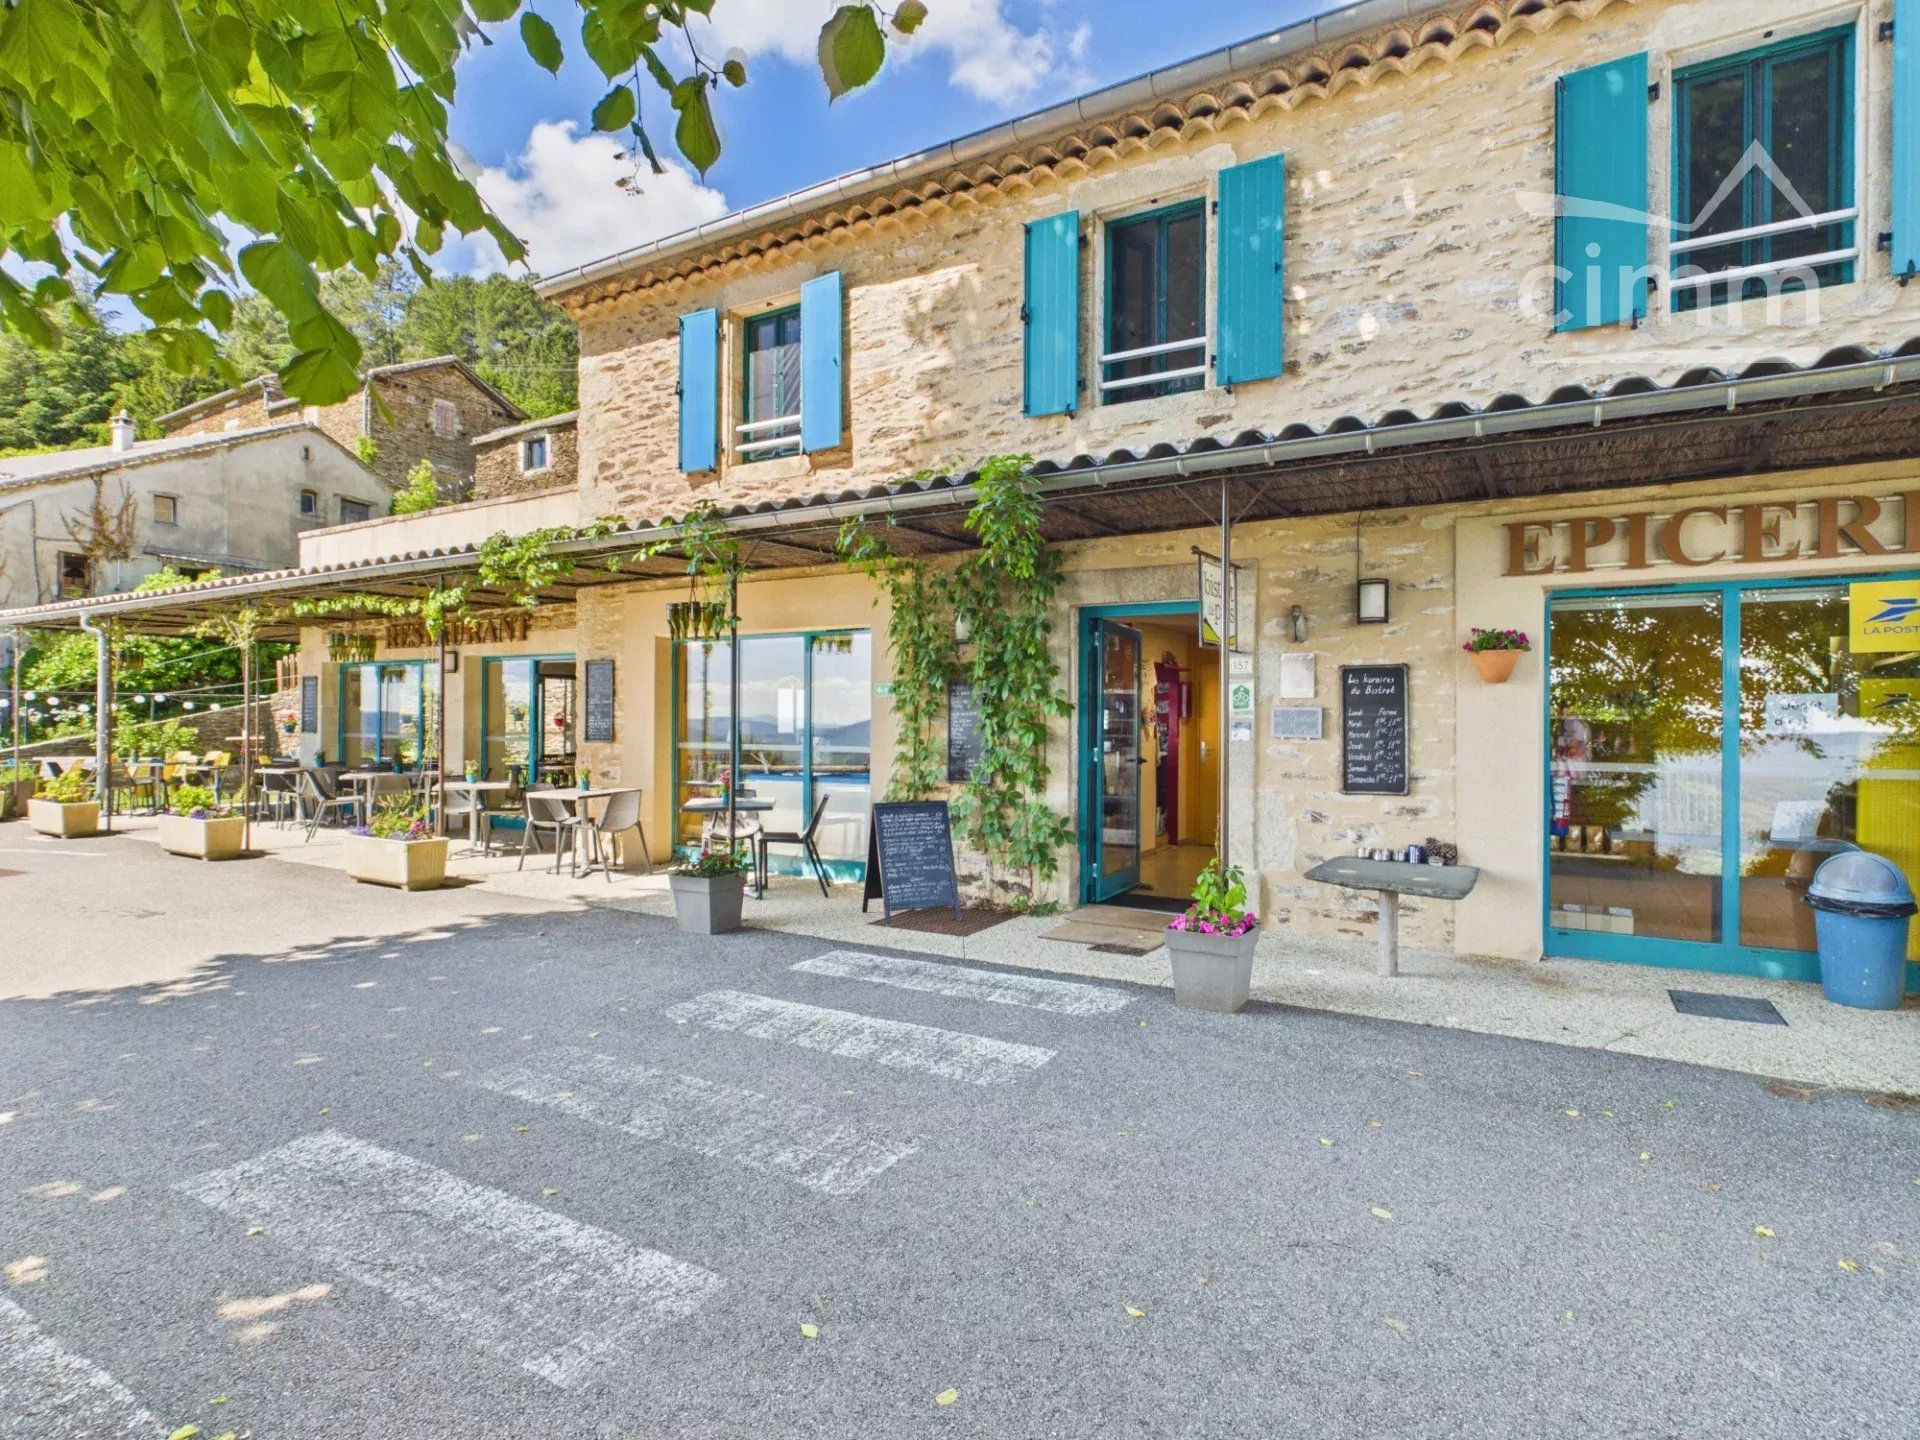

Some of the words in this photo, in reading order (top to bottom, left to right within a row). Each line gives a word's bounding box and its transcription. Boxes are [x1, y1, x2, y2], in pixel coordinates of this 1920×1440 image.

[1863, 627, 1881, 635] LA
[1233, 660, 1249, 671] 157
[1365, 685, 1395, 695] Bistrot
